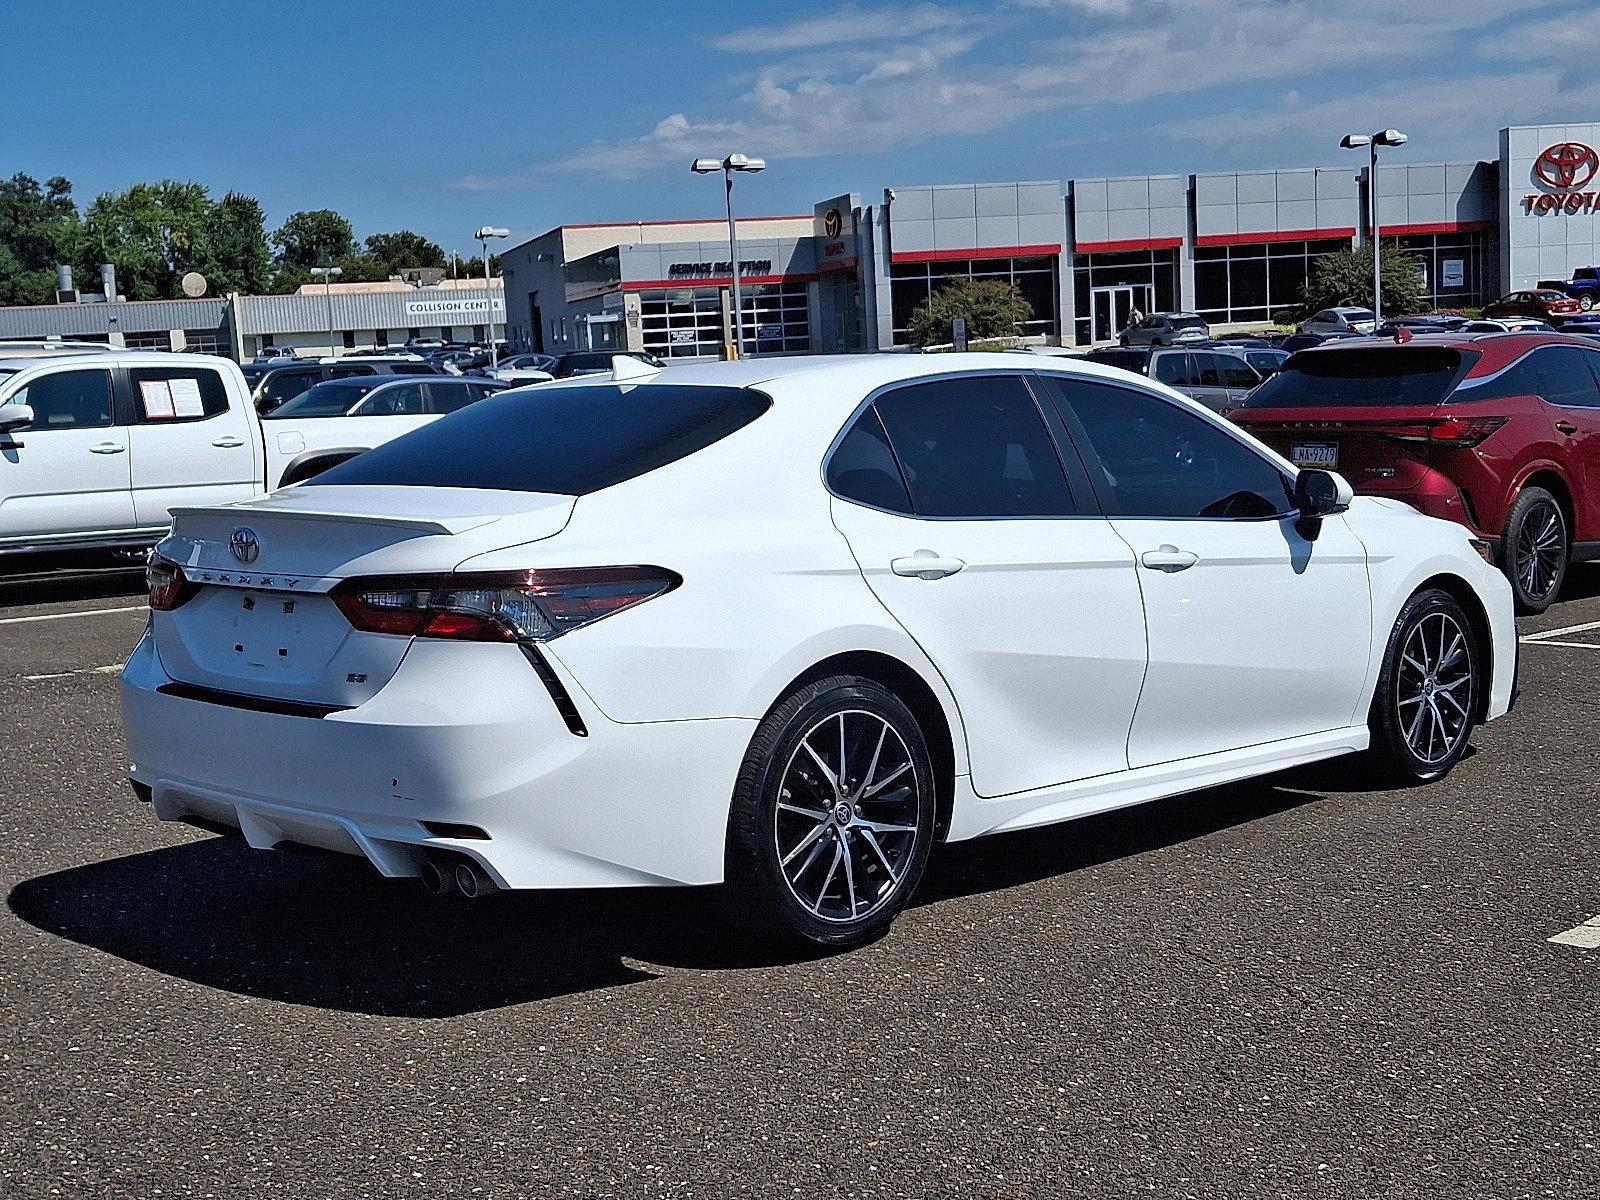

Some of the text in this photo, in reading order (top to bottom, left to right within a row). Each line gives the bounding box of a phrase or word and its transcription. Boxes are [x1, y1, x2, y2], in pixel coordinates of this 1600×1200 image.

[669, 260, 771, 275] SERVICE RECPTION
[410, 301, 499, 312] COLLISION CENTR
